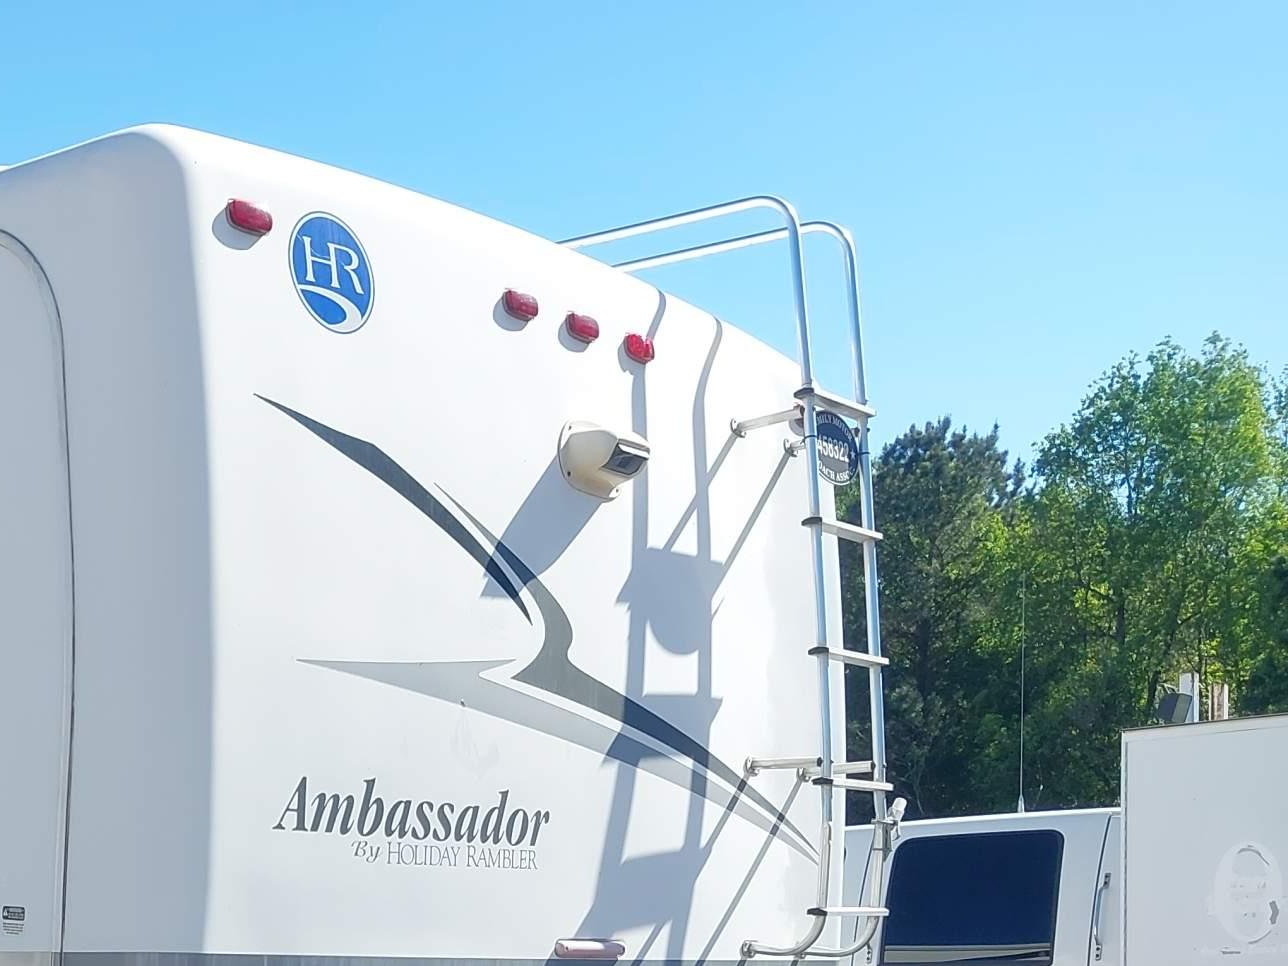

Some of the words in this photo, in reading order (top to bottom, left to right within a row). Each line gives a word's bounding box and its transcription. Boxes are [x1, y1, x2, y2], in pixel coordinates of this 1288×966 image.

[301, 235, 365, 295] HR
[818, 460, 835, 480] OACH
[271, 776, 550, 847] Ambassador
[351, 840, 382, 864] By
[386, 841, 460, 867] HOLIDAY
[466, 845, 538, 870] RAMBLER
